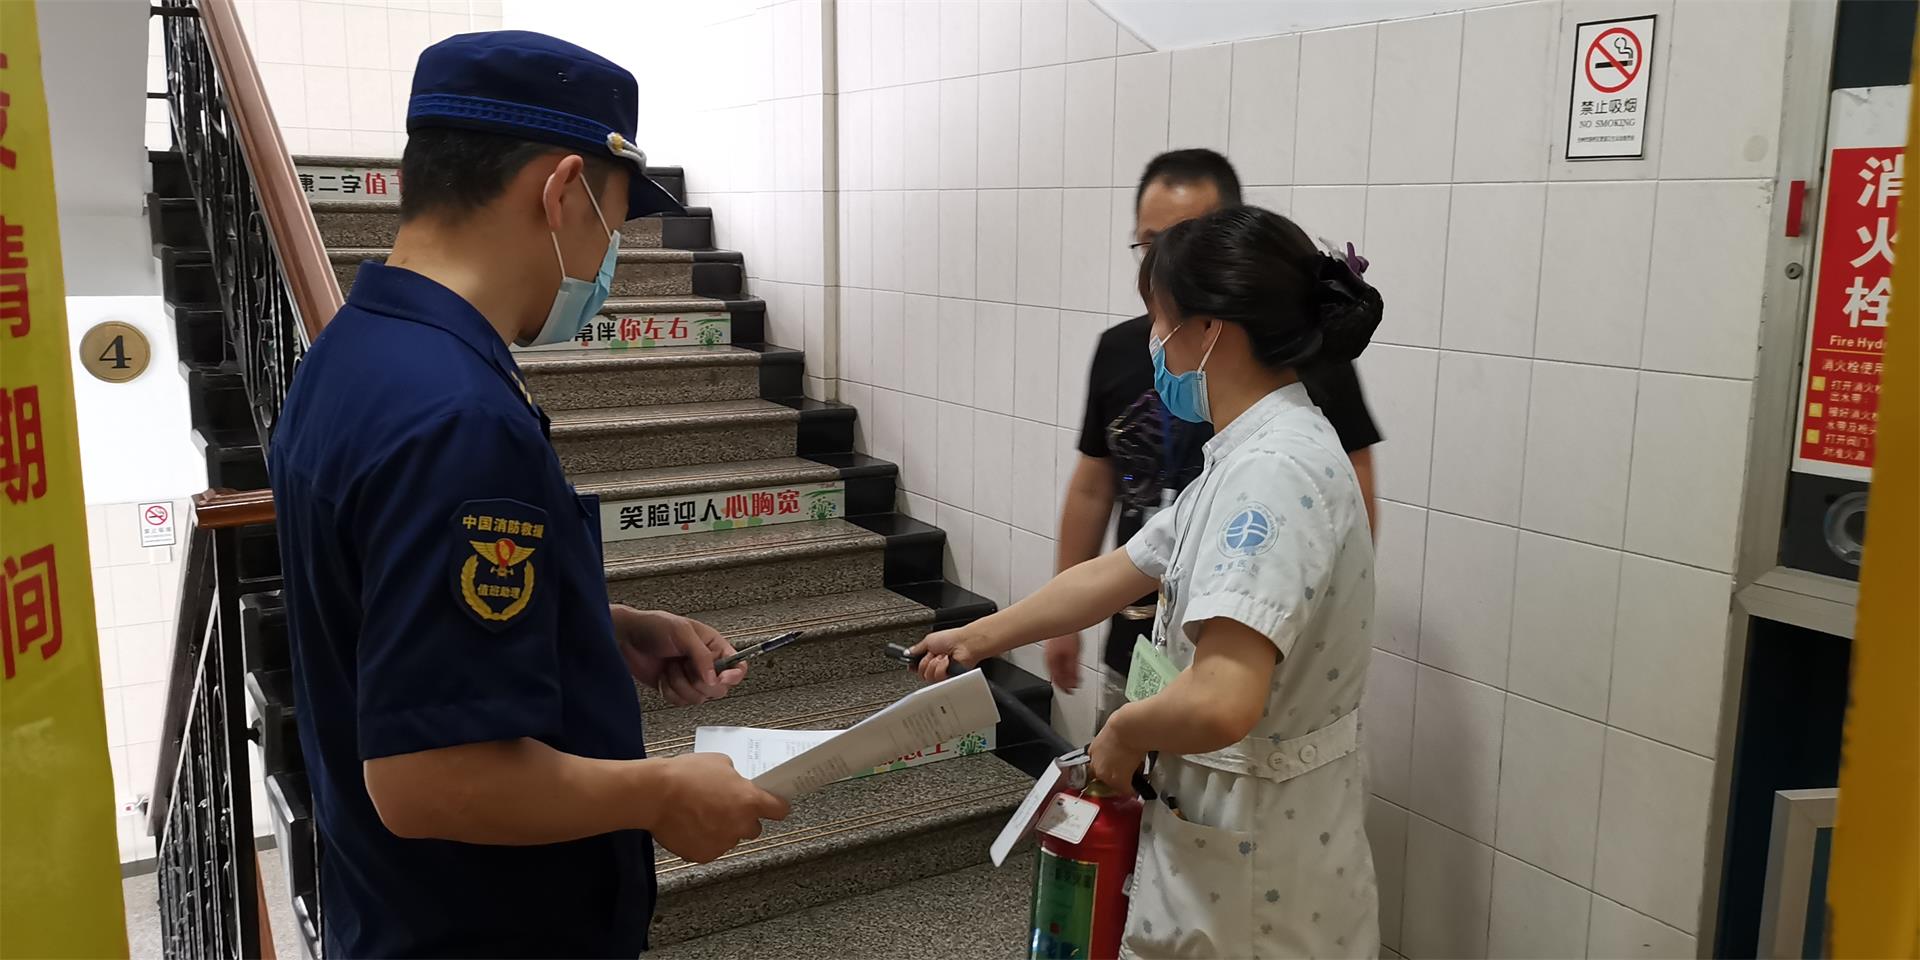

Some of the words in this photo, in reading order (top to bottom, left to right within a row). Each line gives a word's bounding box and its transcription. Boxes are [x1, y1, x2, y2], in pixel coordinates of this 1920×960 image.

[1579, 98, 1637, 115] 禁止吸烟
[1579, 120, 1592, 128] NO
[1595, 118, 1636, 127] SMOKING
[1843, 154, 1904, 328] 消火栓
[99, 335, 132, 369] 4
[1829, 335, 1855, 347] Fire
[620, 489, 800, 530] 笑脸迎人心胸宽
[462, 514, 544, 539] 中国消防救援
